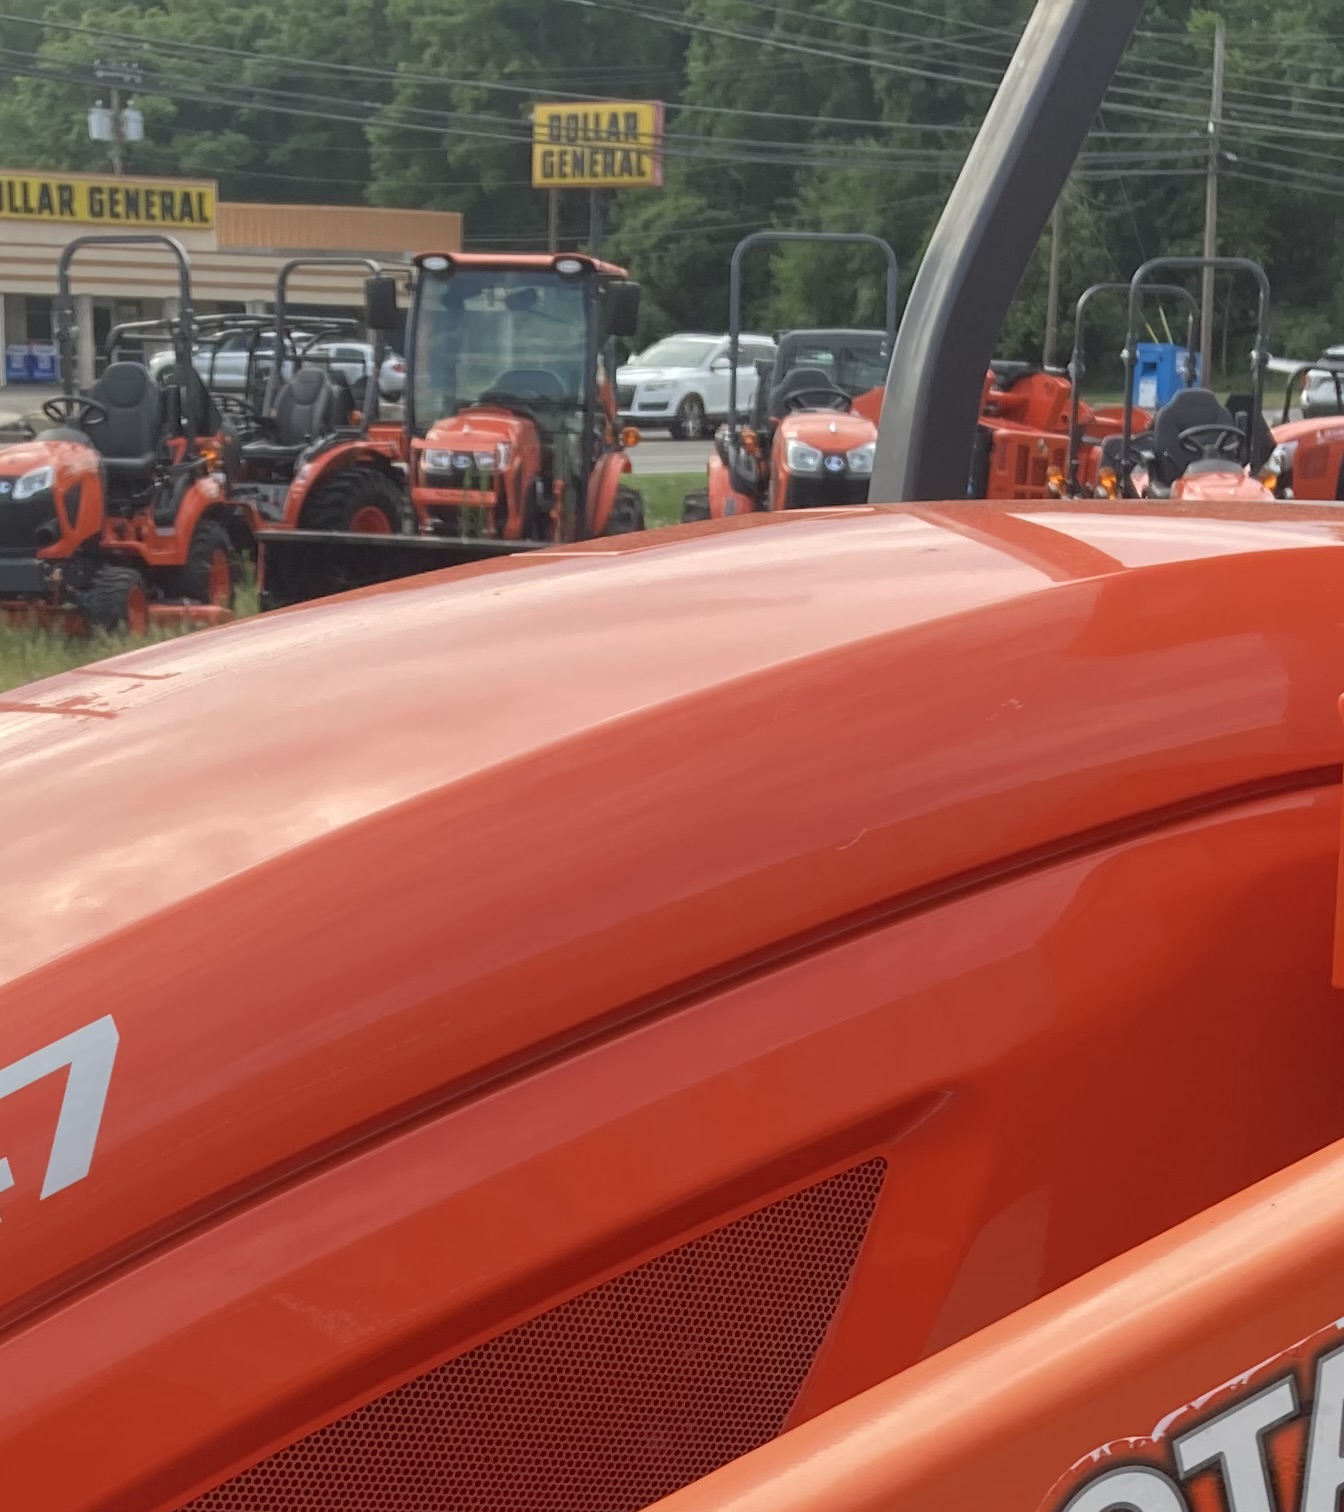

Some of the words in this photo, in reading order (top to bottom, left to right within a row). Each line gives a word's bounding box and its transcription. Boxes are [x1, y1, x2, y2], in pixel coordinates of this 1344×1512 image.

[549, 112, 638, 142] DOLLAR
[542, 147, 646, 178] GENERAL
[87, 186, 210, 223] GENERAL
